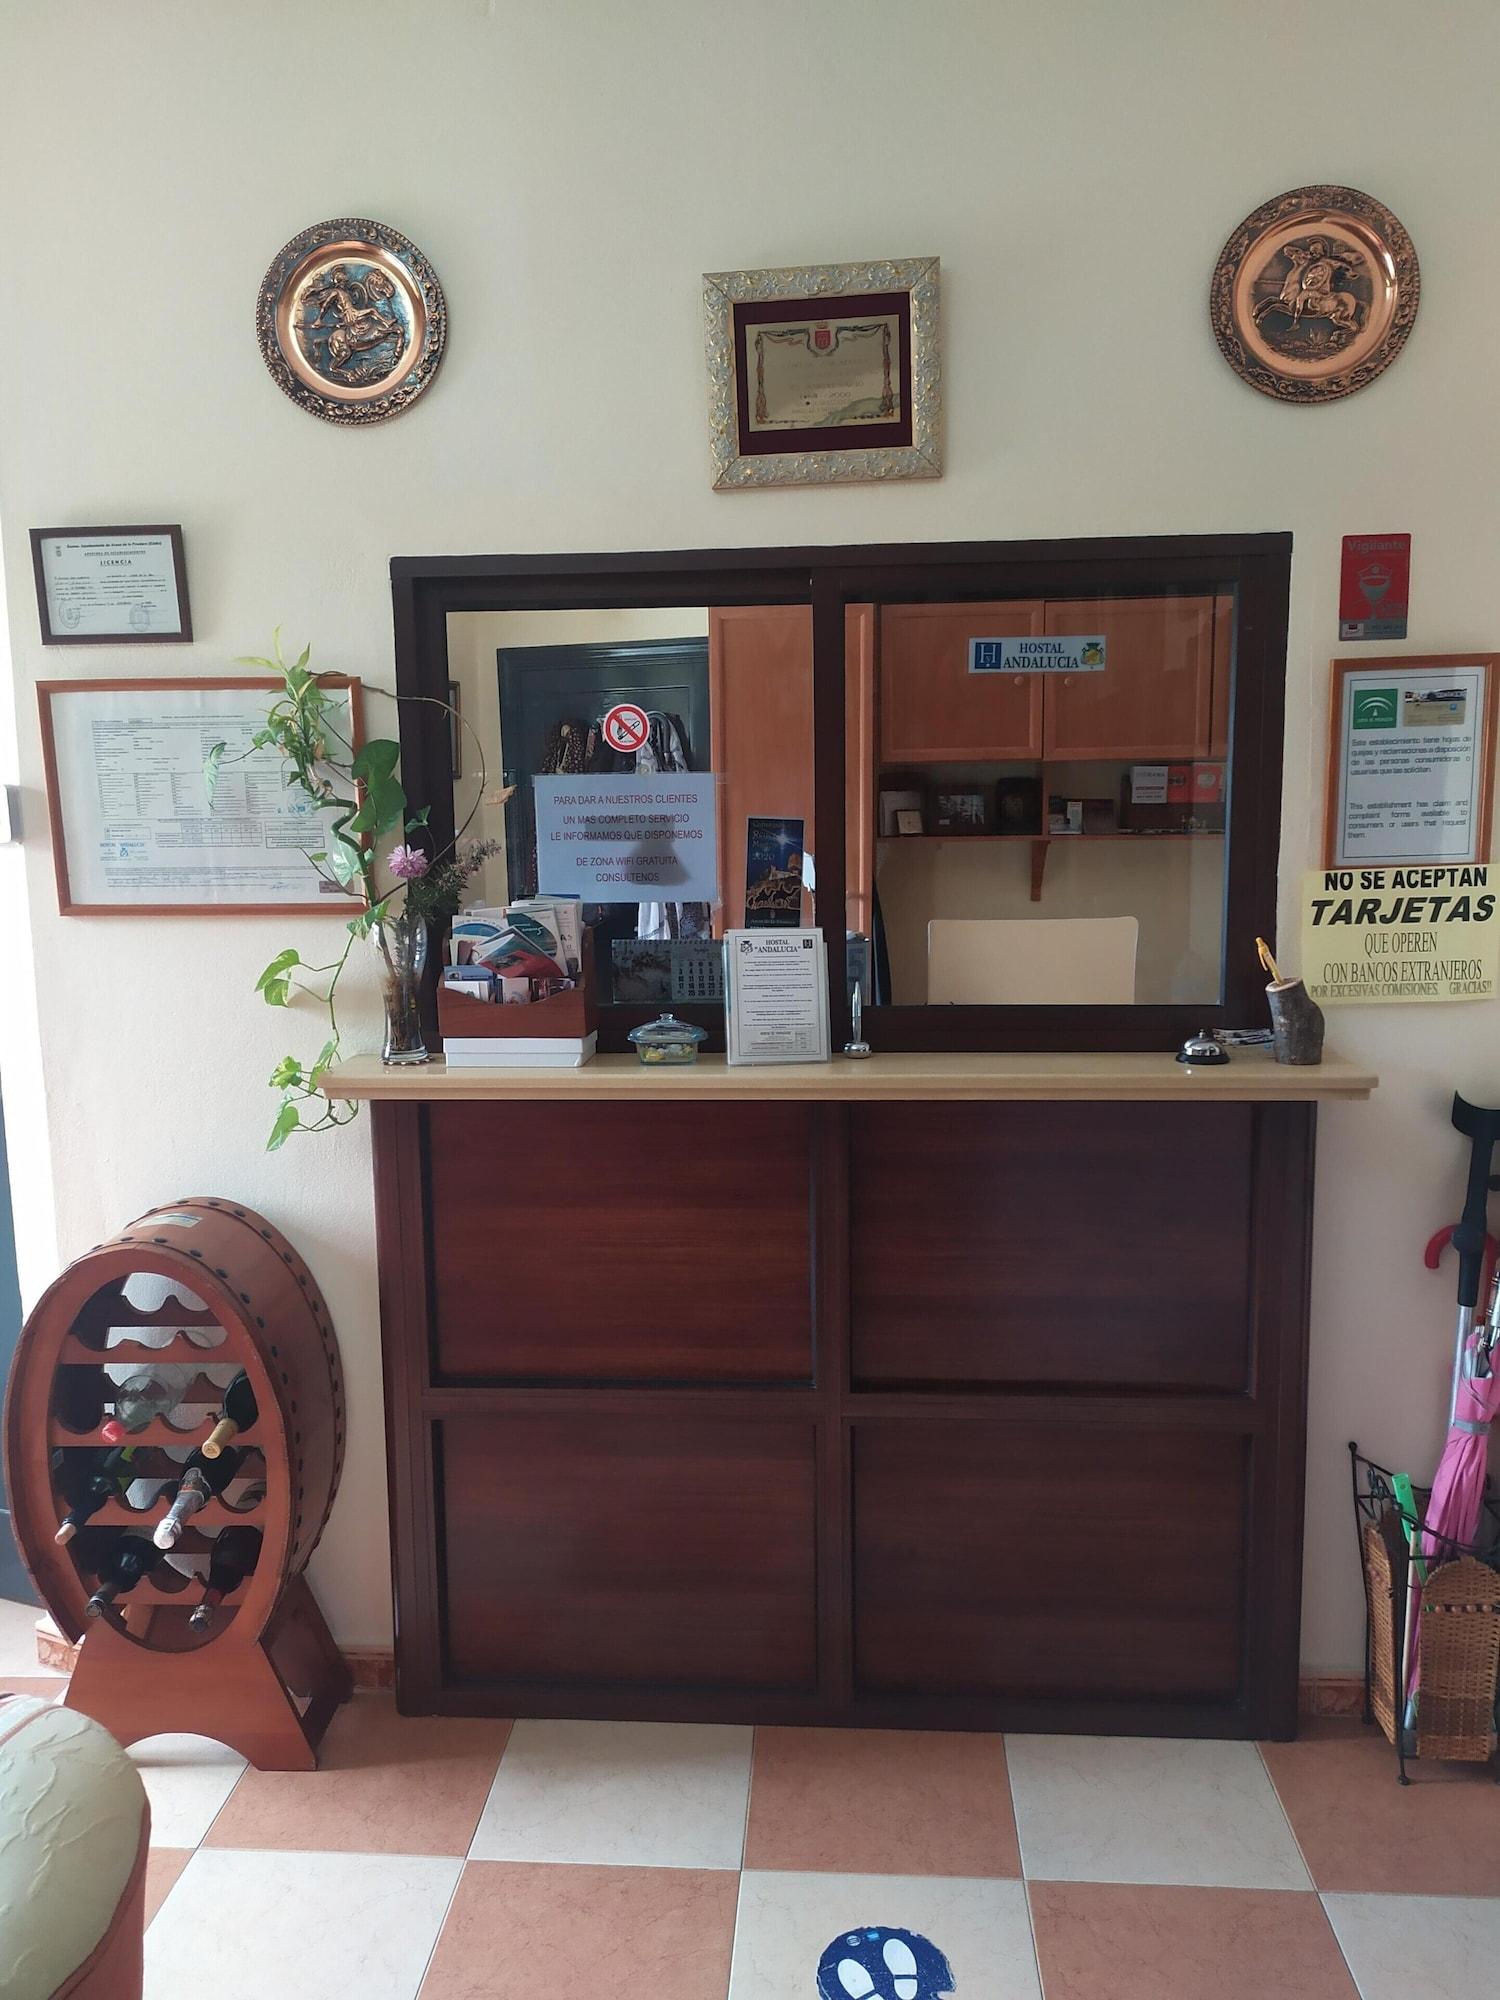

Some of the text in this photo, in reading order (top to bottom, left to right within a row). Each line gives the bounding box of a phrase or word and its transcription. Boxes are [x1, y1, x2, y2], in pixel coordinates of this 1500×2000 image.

[1020, 643, 1064, 653] HOSTAL
[1003, 656, 1079, 668] ANDALUCIA
[554, 794, 698, 804] PARA DAR A NUESTROS CLIENTES
[563, 814, 690, 825] UN MAS COMPLETO SERVICIO
[551, 831, 702, 842] LE INFORMAMOS QUE DISPONEMOS
[576, 857, 678, 866] DE ZONA WIFI GRATUITA
[596, 872, 660, 882] CONSULTENOS
[1325, 867, 1487, 891] NO SE ACEPTAN
[1311, 895, 1496, 926] TARJETAS
[1364, 932, 1438, 958] QUE OPEREN
[1324, 959, 1482, 983] CON BANCOS EXTRANJEROS
[1311, 986, 1329, 997] POR
[1330, 984, 1380, 997] EXCESIVAS
